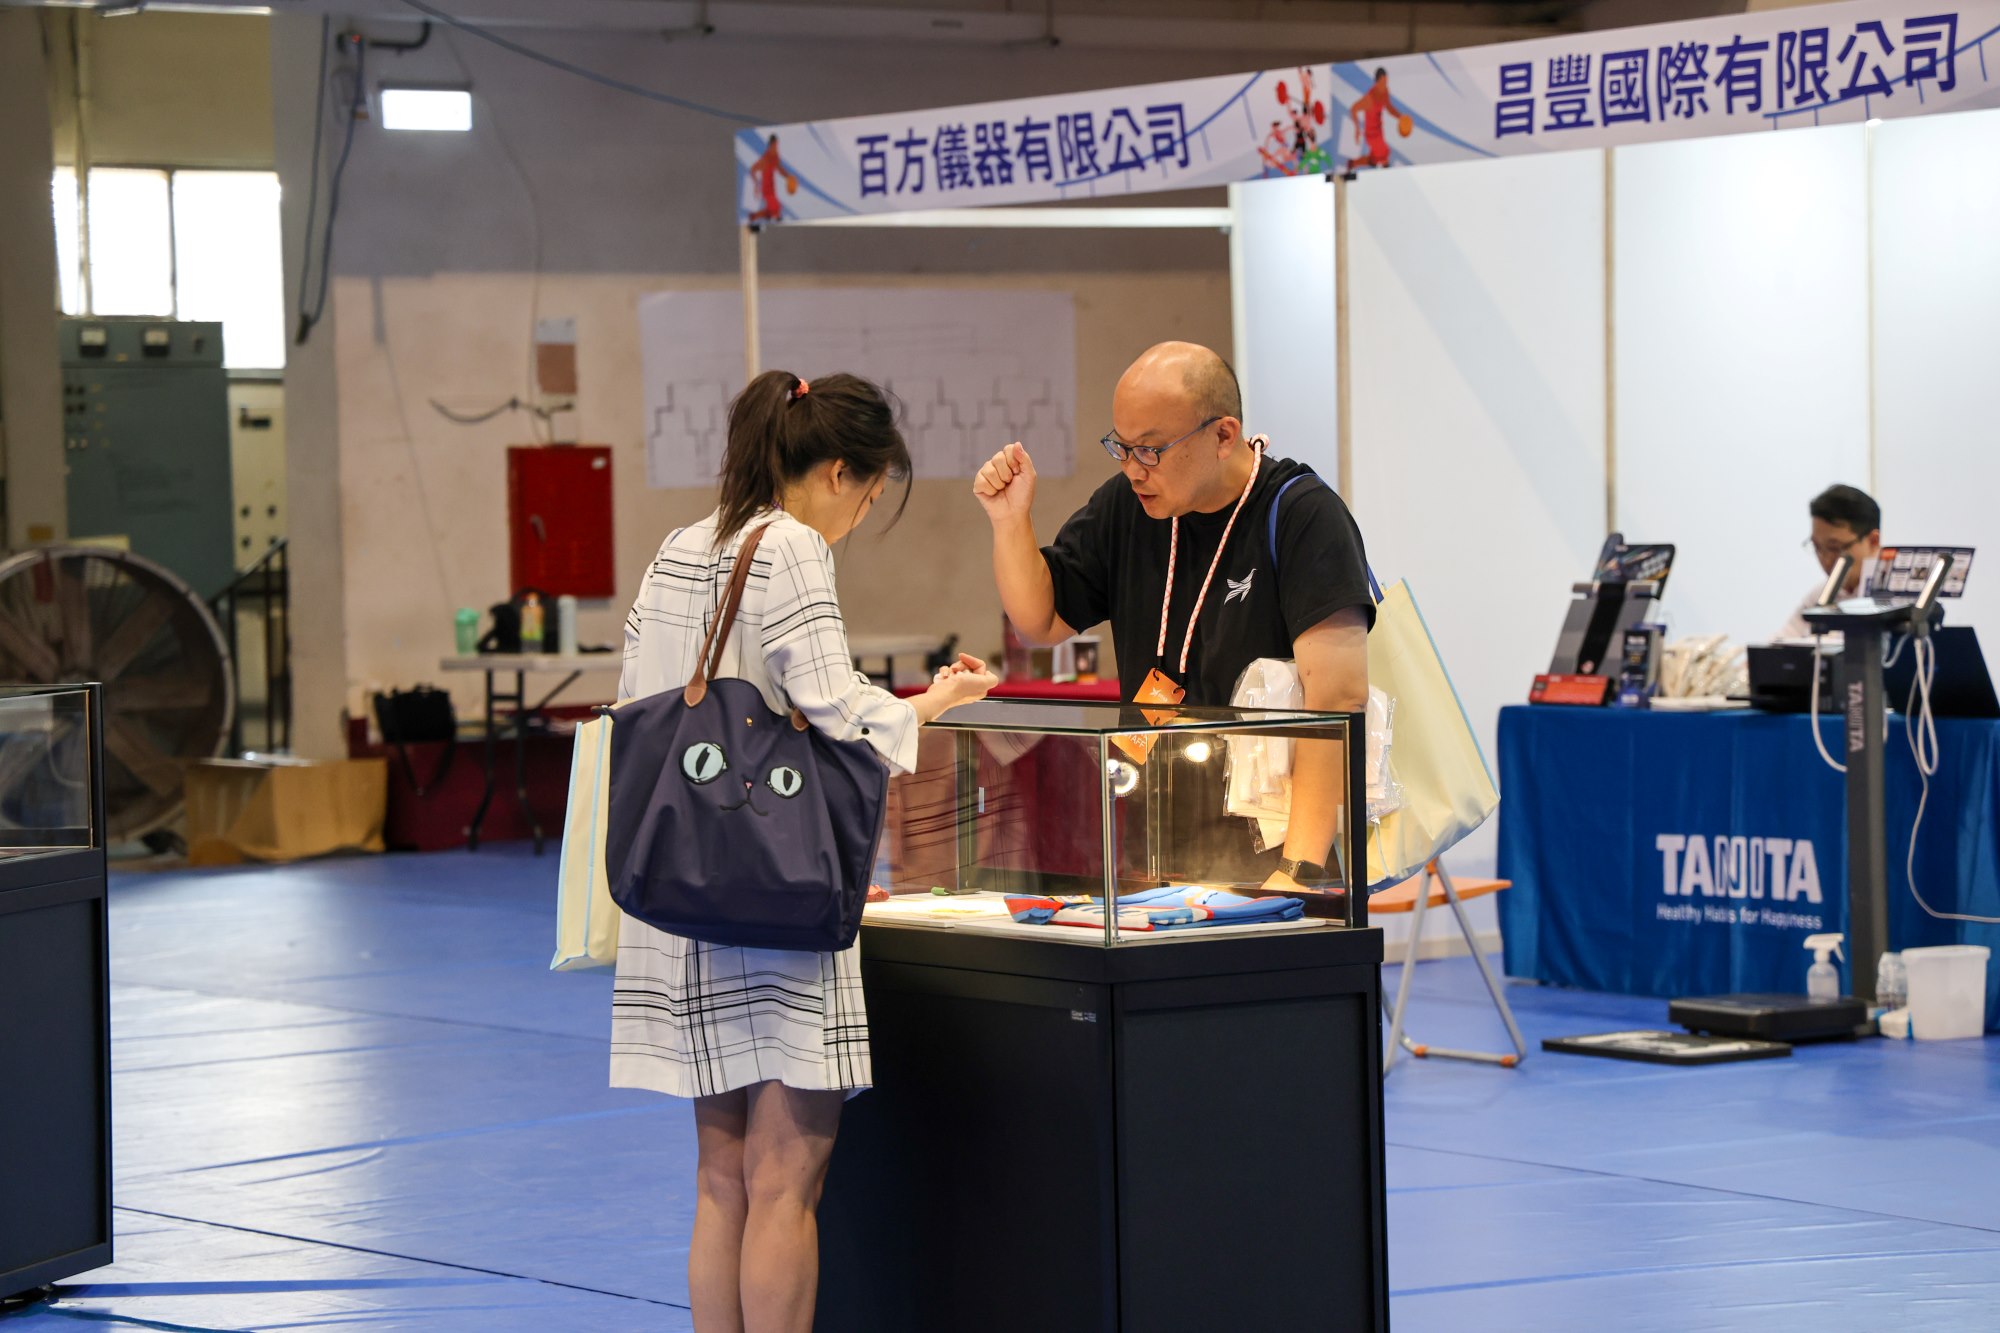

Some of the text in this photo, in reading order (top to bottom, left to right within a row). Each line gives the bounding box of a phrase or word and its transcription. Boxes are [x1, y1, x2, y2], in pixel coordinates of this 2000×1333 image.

[1495, 12, 1959, 138] 昌豐國際有限公司
[856, 103, 1191, 198] 百方儀器有限公司
[1656, 834, 1822, 903] TANITA
[1740, 906, 1759, 924] for
